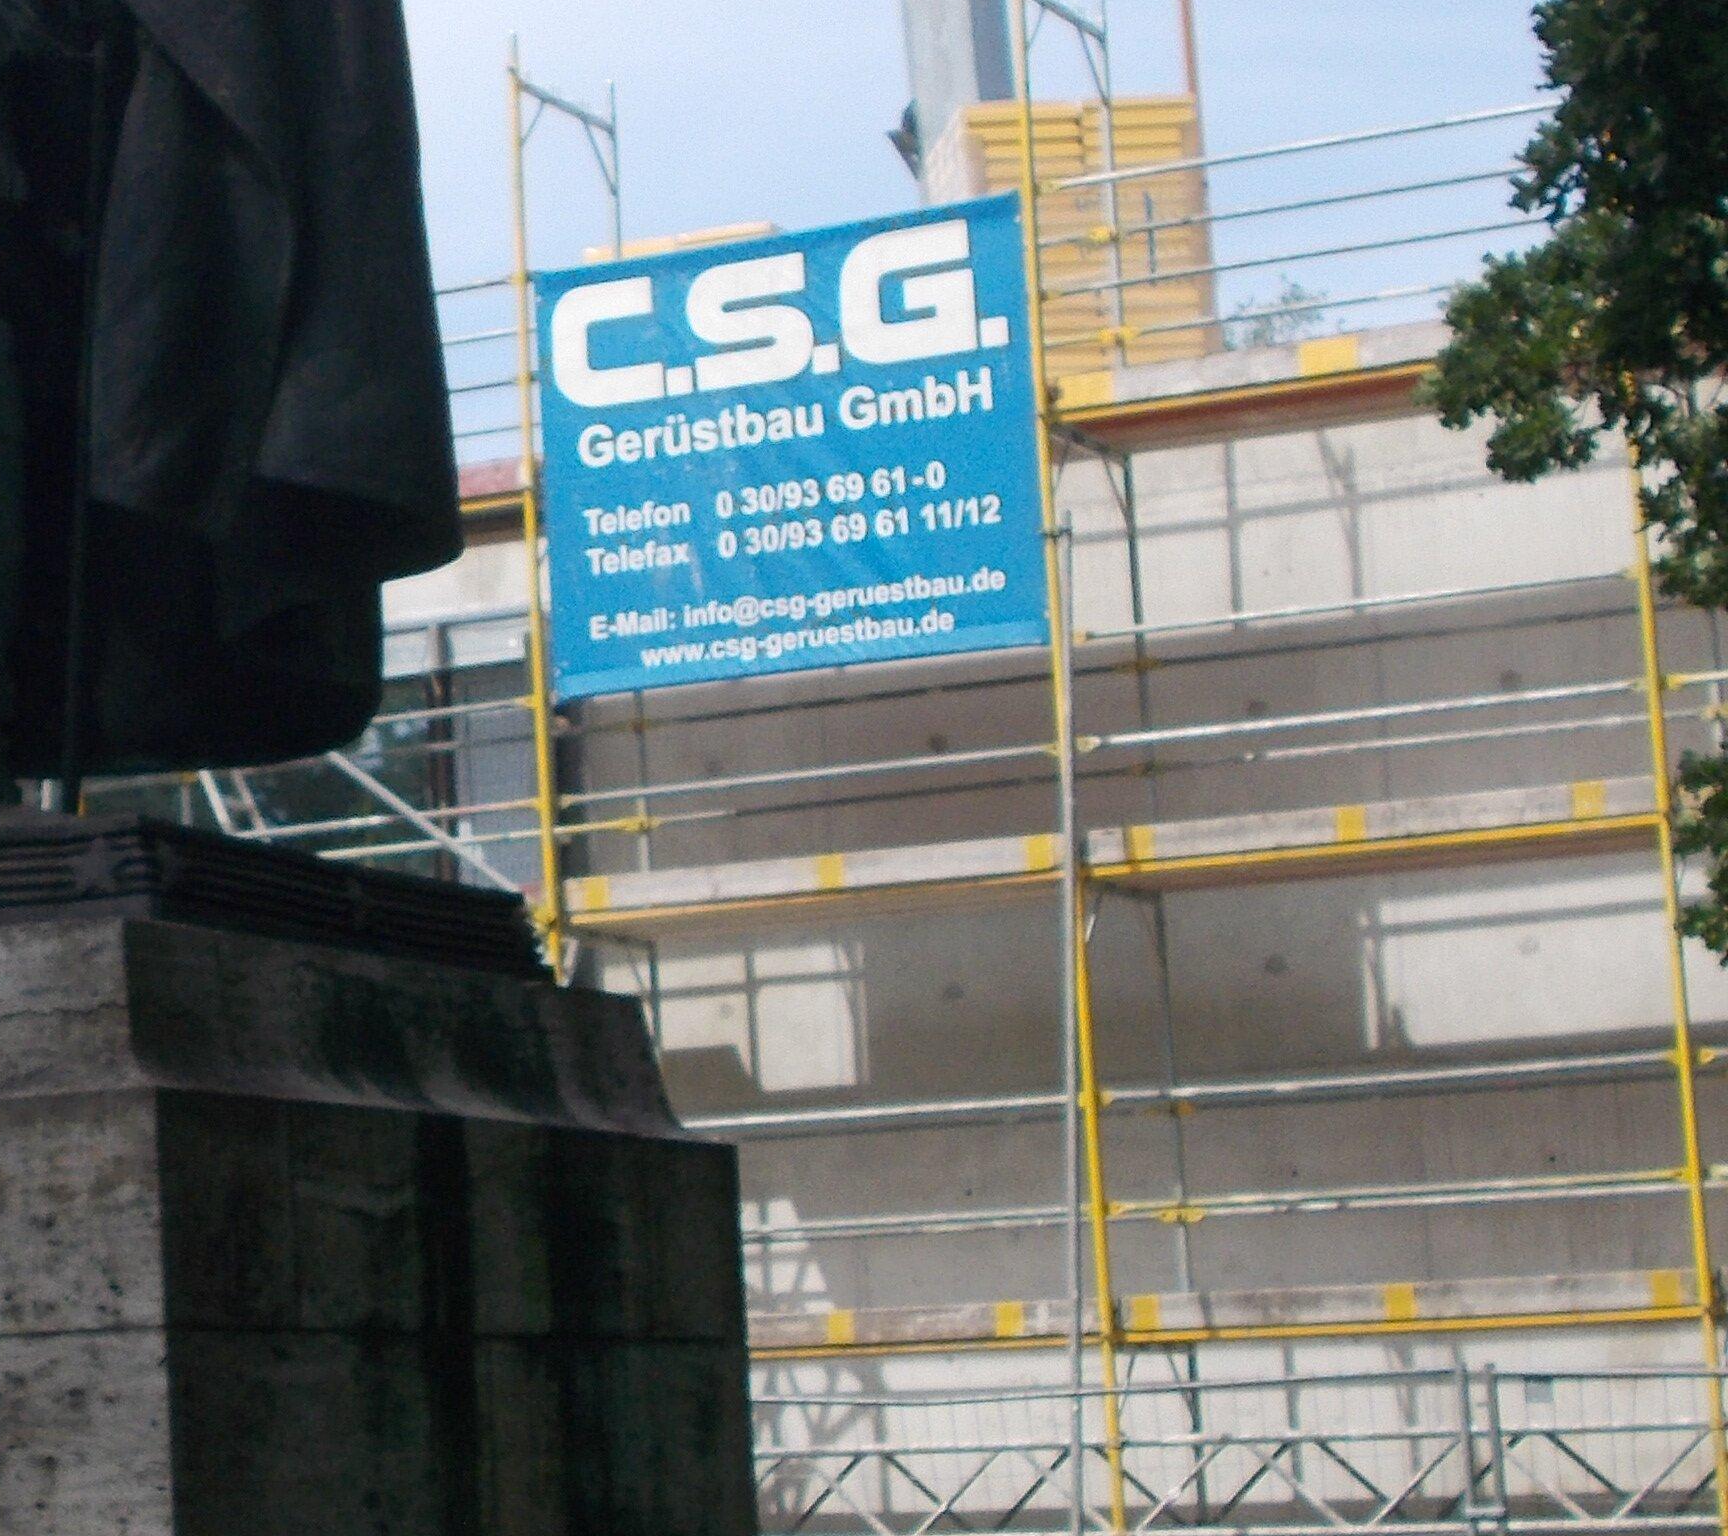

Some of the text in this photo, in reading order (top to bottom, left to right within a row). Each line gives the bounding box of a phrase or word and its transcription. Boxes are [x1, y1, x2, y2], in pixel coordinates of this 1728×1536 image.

[552, 218, 1010, 407] C.S.G.
[578, 366, 994, 467] Gerüstbau GmbH
[583, 499, 691, 537] Telefon
[715, 490, 734, 520] 0
[740, 478, 821, 516] 30/93
[826, 471, 865, 503] 69
[585, 494, 1003, 576] Telefax 0 30/93 69 61 11/12
[589, 566, 1007, 641] E-Mail: info@csg-geruestbau.de
[640, 609, 955, 668] www.csg-geruestbau.de
